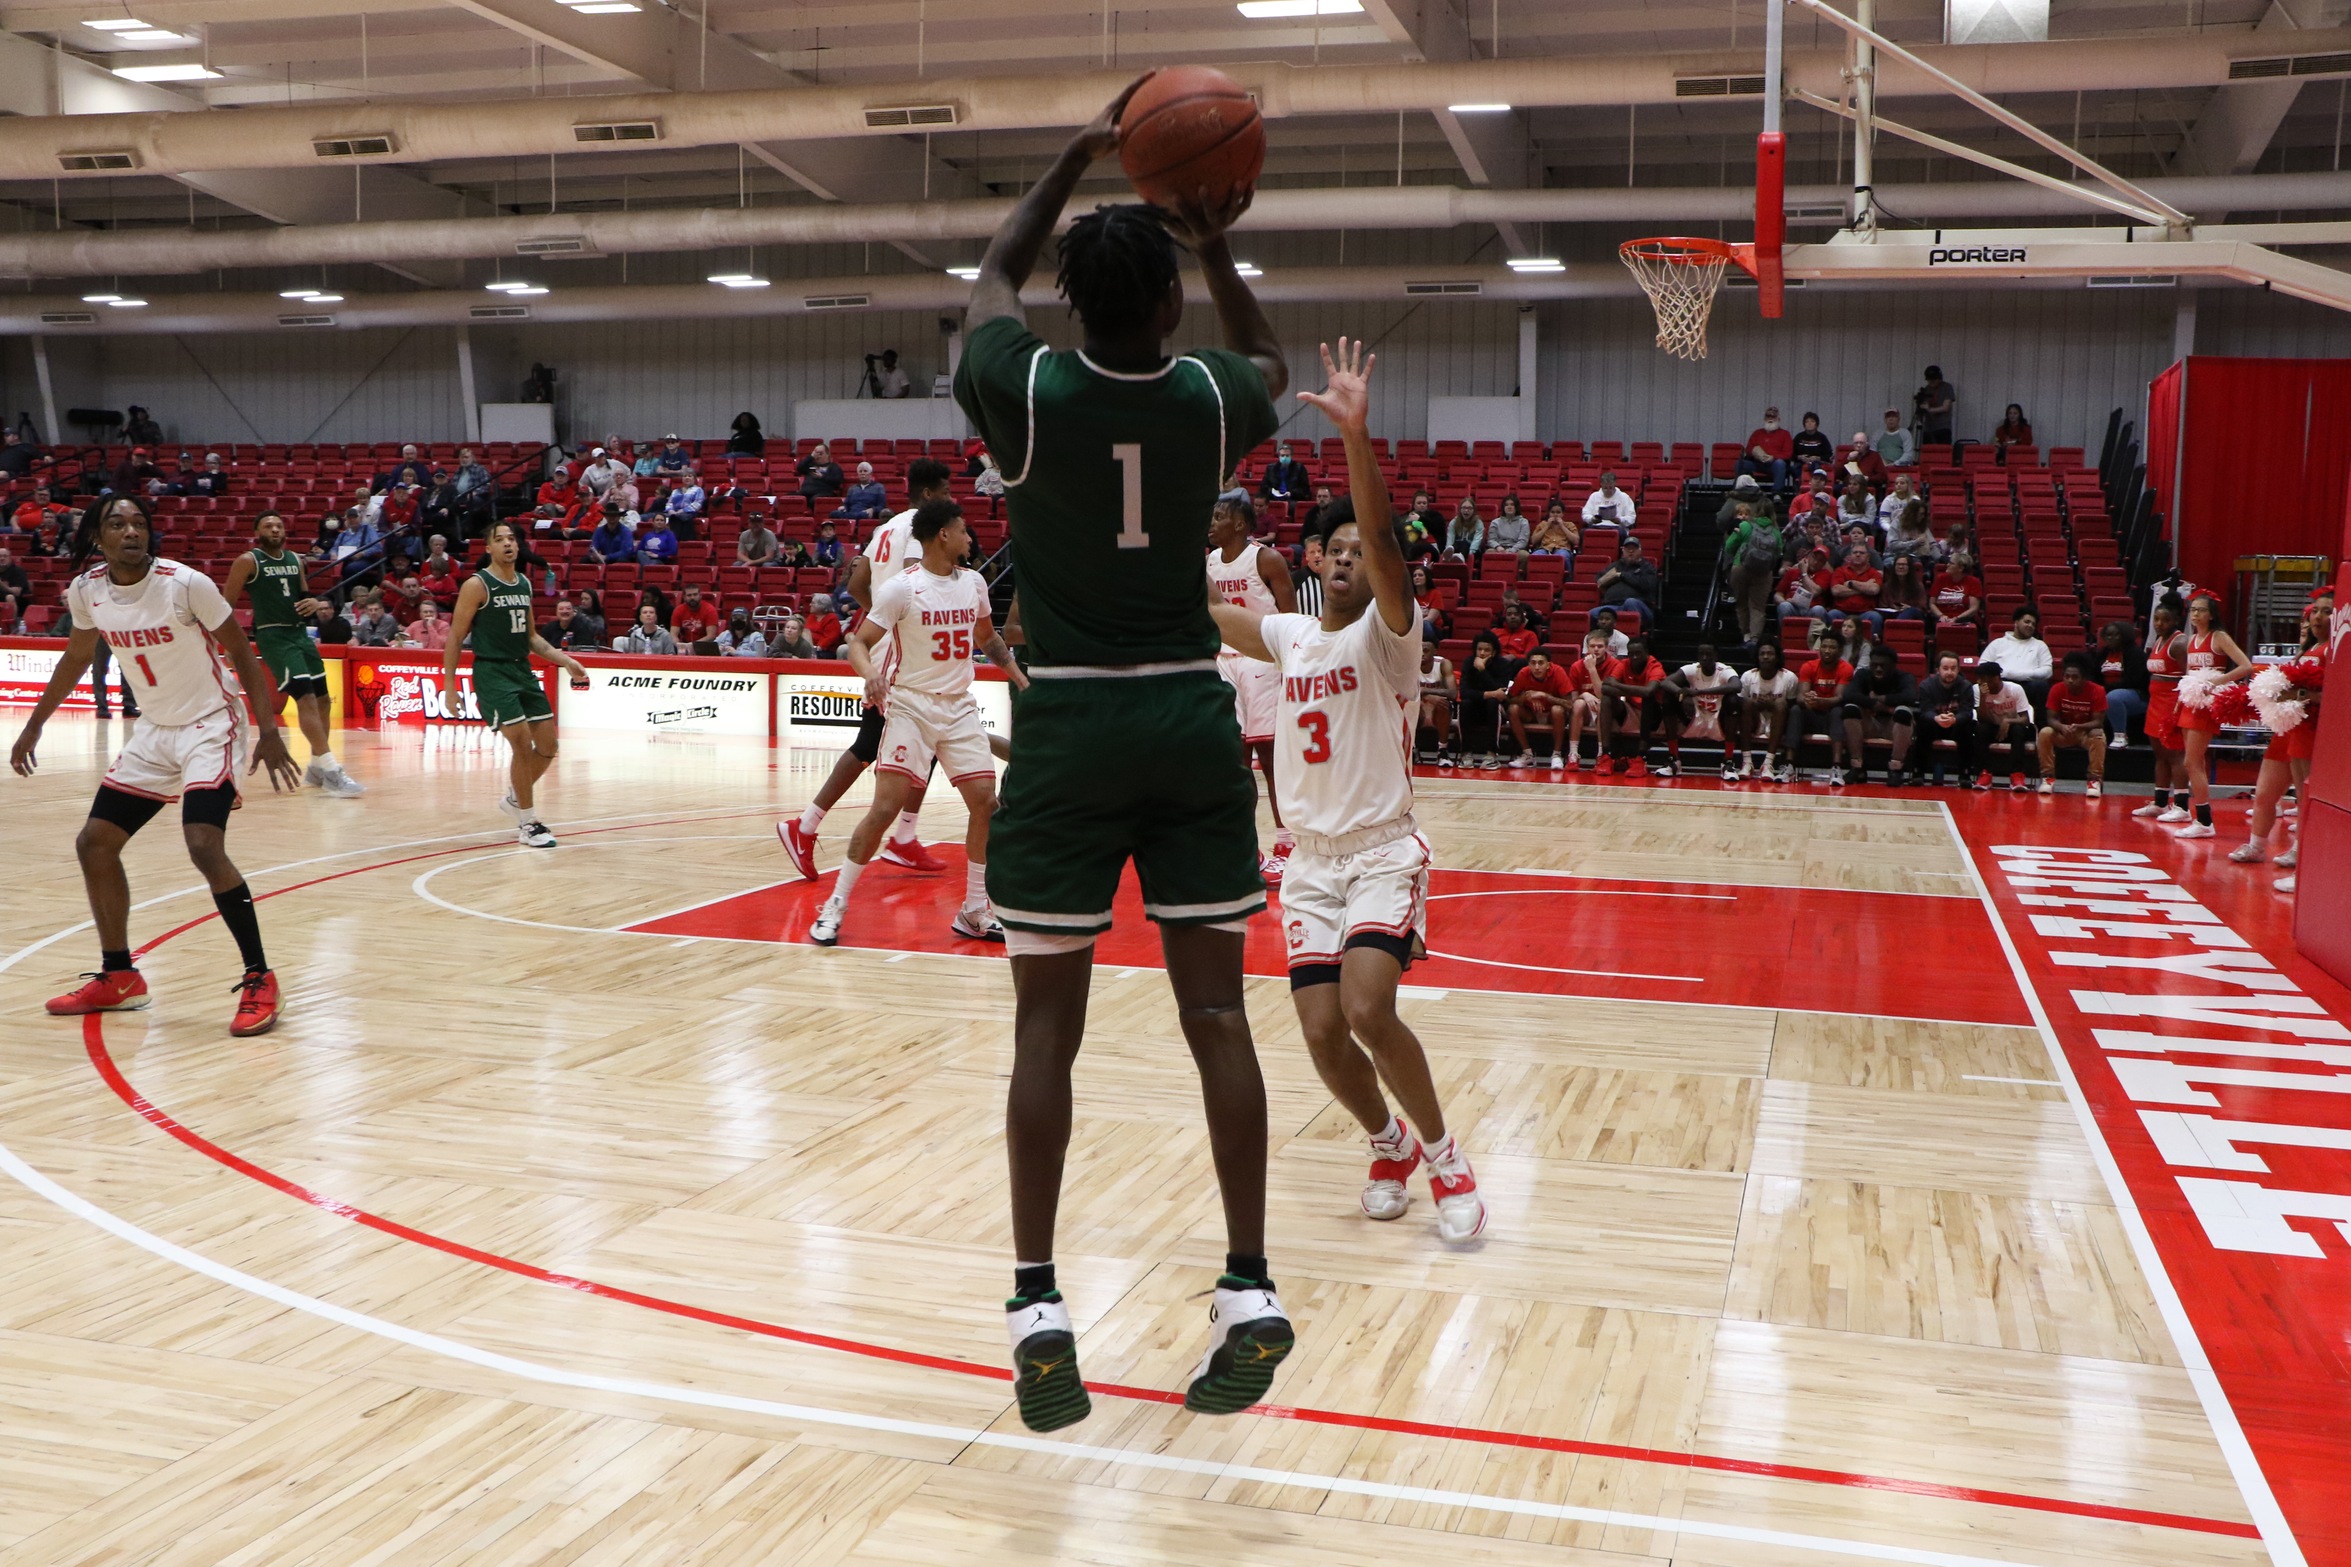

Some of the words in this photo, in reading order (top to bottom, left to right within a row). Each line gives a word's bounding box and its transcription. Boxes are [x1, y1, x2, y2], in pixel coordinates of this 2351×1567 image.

[1112, 443, 1150, 549] 1
[263, 566, 299, 577] SEWARD
[279, 577, 291, 597] 3
[493, 594, 531, 609] SEWARD
[508, 609, 527, 633] 12
[921, 608, 976, 626] RAVENS
[931, 629, 970, 662] 35
[8, 653, 57, 674] Wind
[134, 653, 158, 687] 1
[378, 664, 439, 676] COFFEYVILLE
[393, 677, 425, 703] Red
[608, 676, 663, 688] ACME
[668, 678, 757, 692] FOUNDRY
[790, 683, 861, 693] COFFEYVI
[1286, 665, 1359, 703] AVENS
[380, 699, 424, 720] Raven
[1298, 710, 1332, 765] 3
